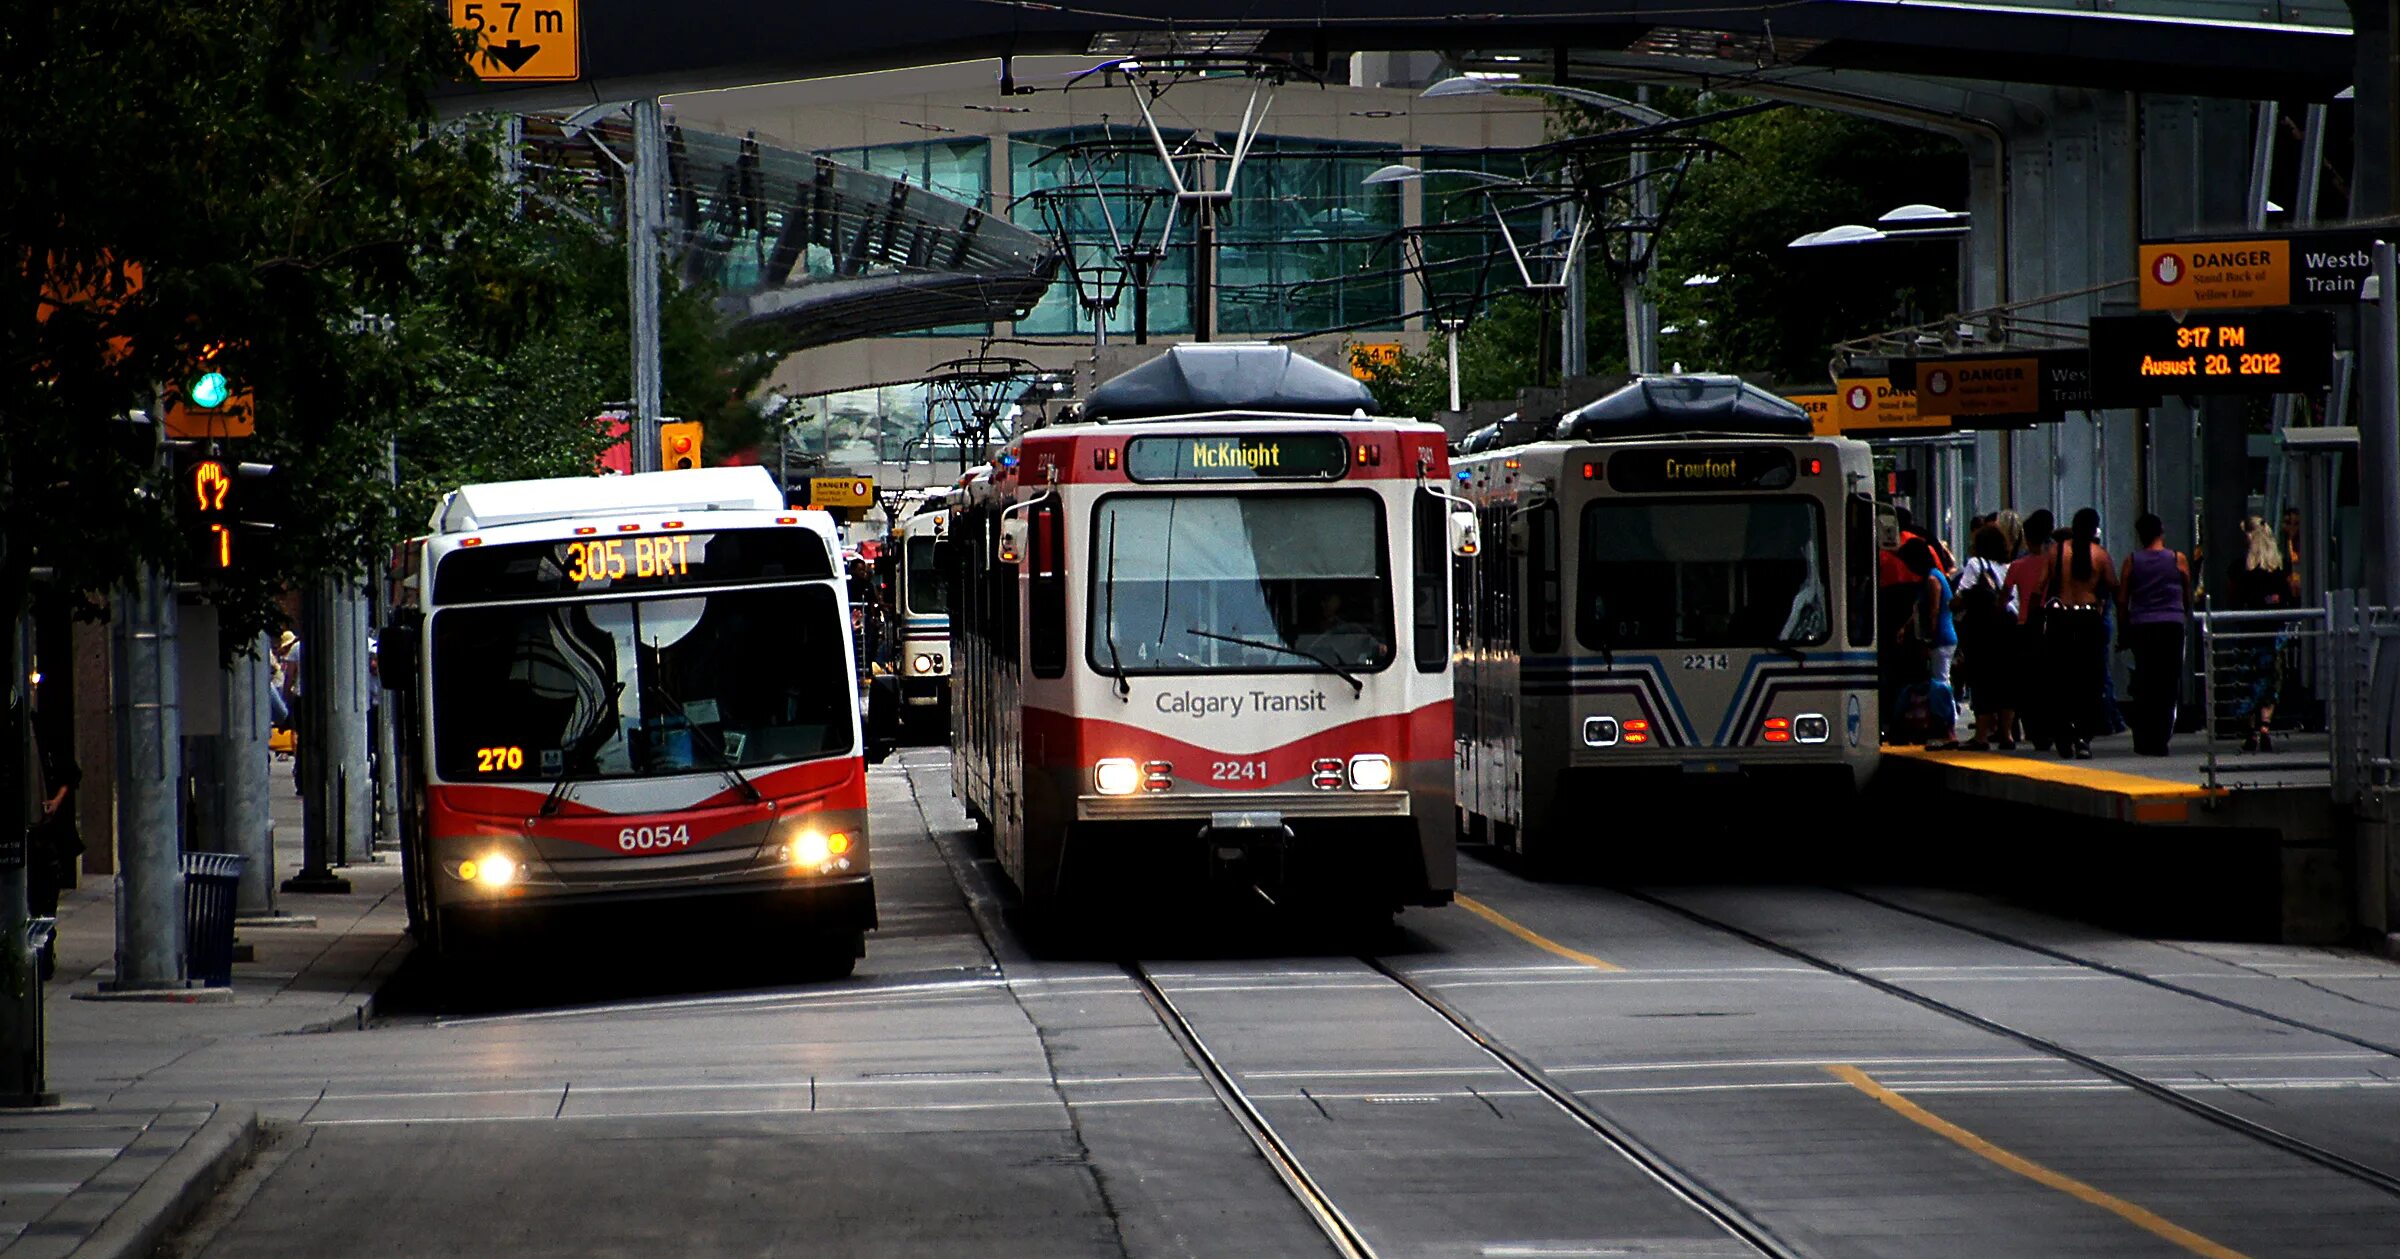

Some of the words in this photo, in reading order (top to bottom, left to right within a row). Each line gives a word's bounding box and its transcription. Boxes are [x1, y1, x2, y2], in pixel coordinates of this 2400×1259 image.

[465, 3, 521, 33] 5.7
[535, 10, 563, 33] m
[2193, 251, 2271, 268] DANGER
[2305, 250, 2373, 269] Westb
[2305, 275, 2356, 292] Train
[2176, 326, 2211, 349] 3:17
[2218, 326, 2245, 348] PM
[1959, 367, 2024, 383] DANGER
[2140, 354, 2197, 376] August
[2240, 352, 2281, 375] 2012
[1192, 442, 1280, 470] McKnight
[1666, 458, 1738, 479] Crowfoot
[567, 540, 627, 583] 305
[635, 534, 692, 579] BRT
[1684, 654, 1728, 670] 2214
[1156, 690, 1244, 718] Calgary
[1249, 689, 1326, 712] Transit
[476, 745, 524, 773] 270
[1211, 761, 1268, 780] 2241
[618, 823, 690, 851] 6054
